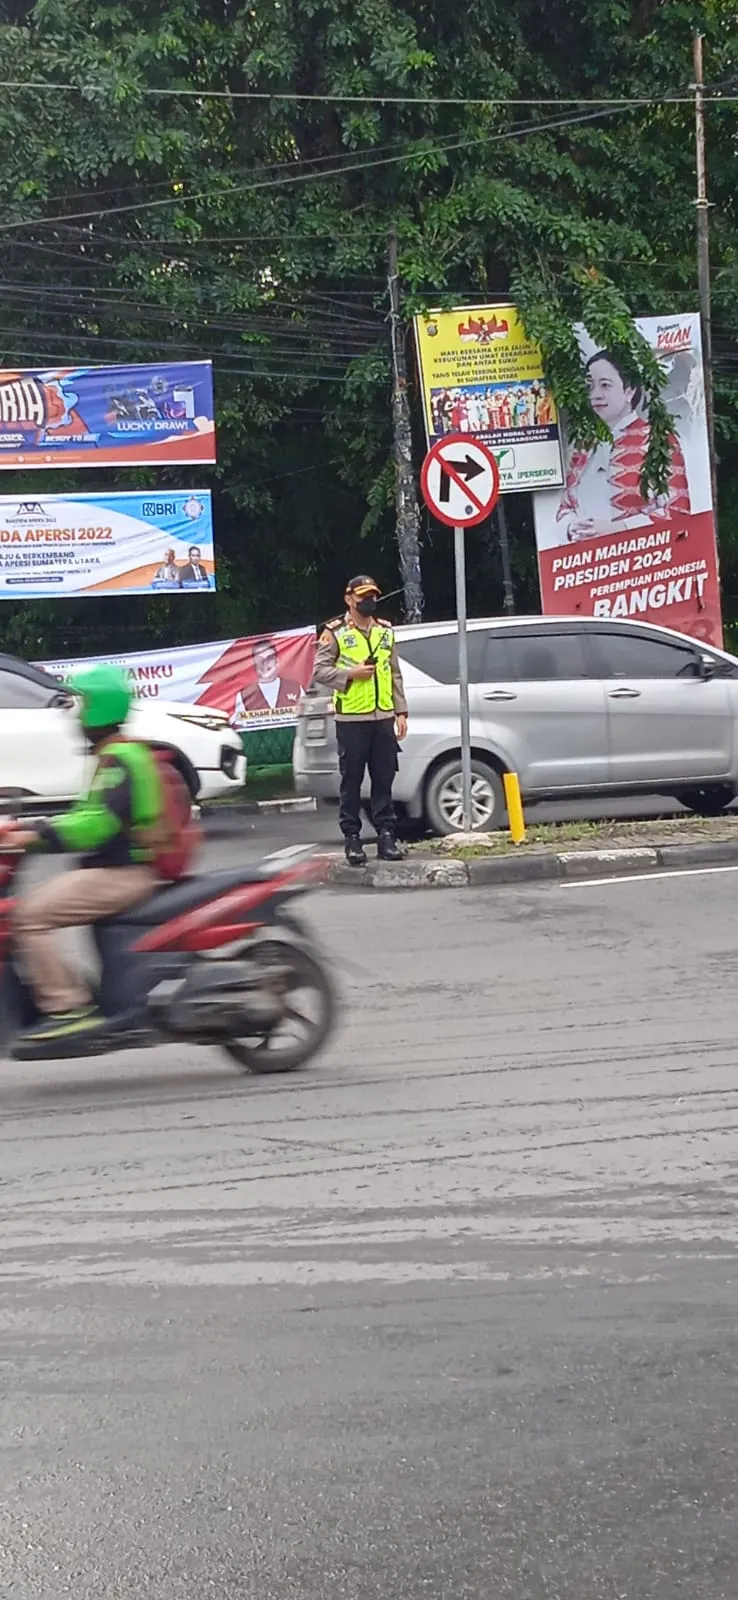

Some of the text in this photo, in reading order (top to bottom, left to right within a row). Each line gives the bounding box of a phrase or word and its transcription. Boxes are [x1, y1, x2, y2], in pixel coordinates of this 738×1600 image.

[460, 347, 492, 355] BERSAMA
[434, 354, 478, 363] KERUKUNAN
[432, 371, 450, 379] YANG
[452, 370, 471, 378] TELAH
[472, 368, 497, 376] TERBINA
[499, 366, 525, 374] DENGAN
[465, 374, 497, 383] SUMATERA
[499, 372, 518, 380] UTARA
[117, 421, 189, 432] LUCKY DRAW!
[527, 428, 550, 436] UTAMA
[24, 528, 76, 542] APERSI
[78, 527, 112, 540] 2022
[23, 551, 75, 559] BERKEMBANG
[552, 530, 671, 573] PUAN MAHARANI
[32, 557, 73, 566] SUMATERA
[554, 547, 672, 591] PRESIDEN 2024
[590, 559, 707, 598] PEREMPUAN INDONESIA
[594, 572, 708, 617] BANGKIT
